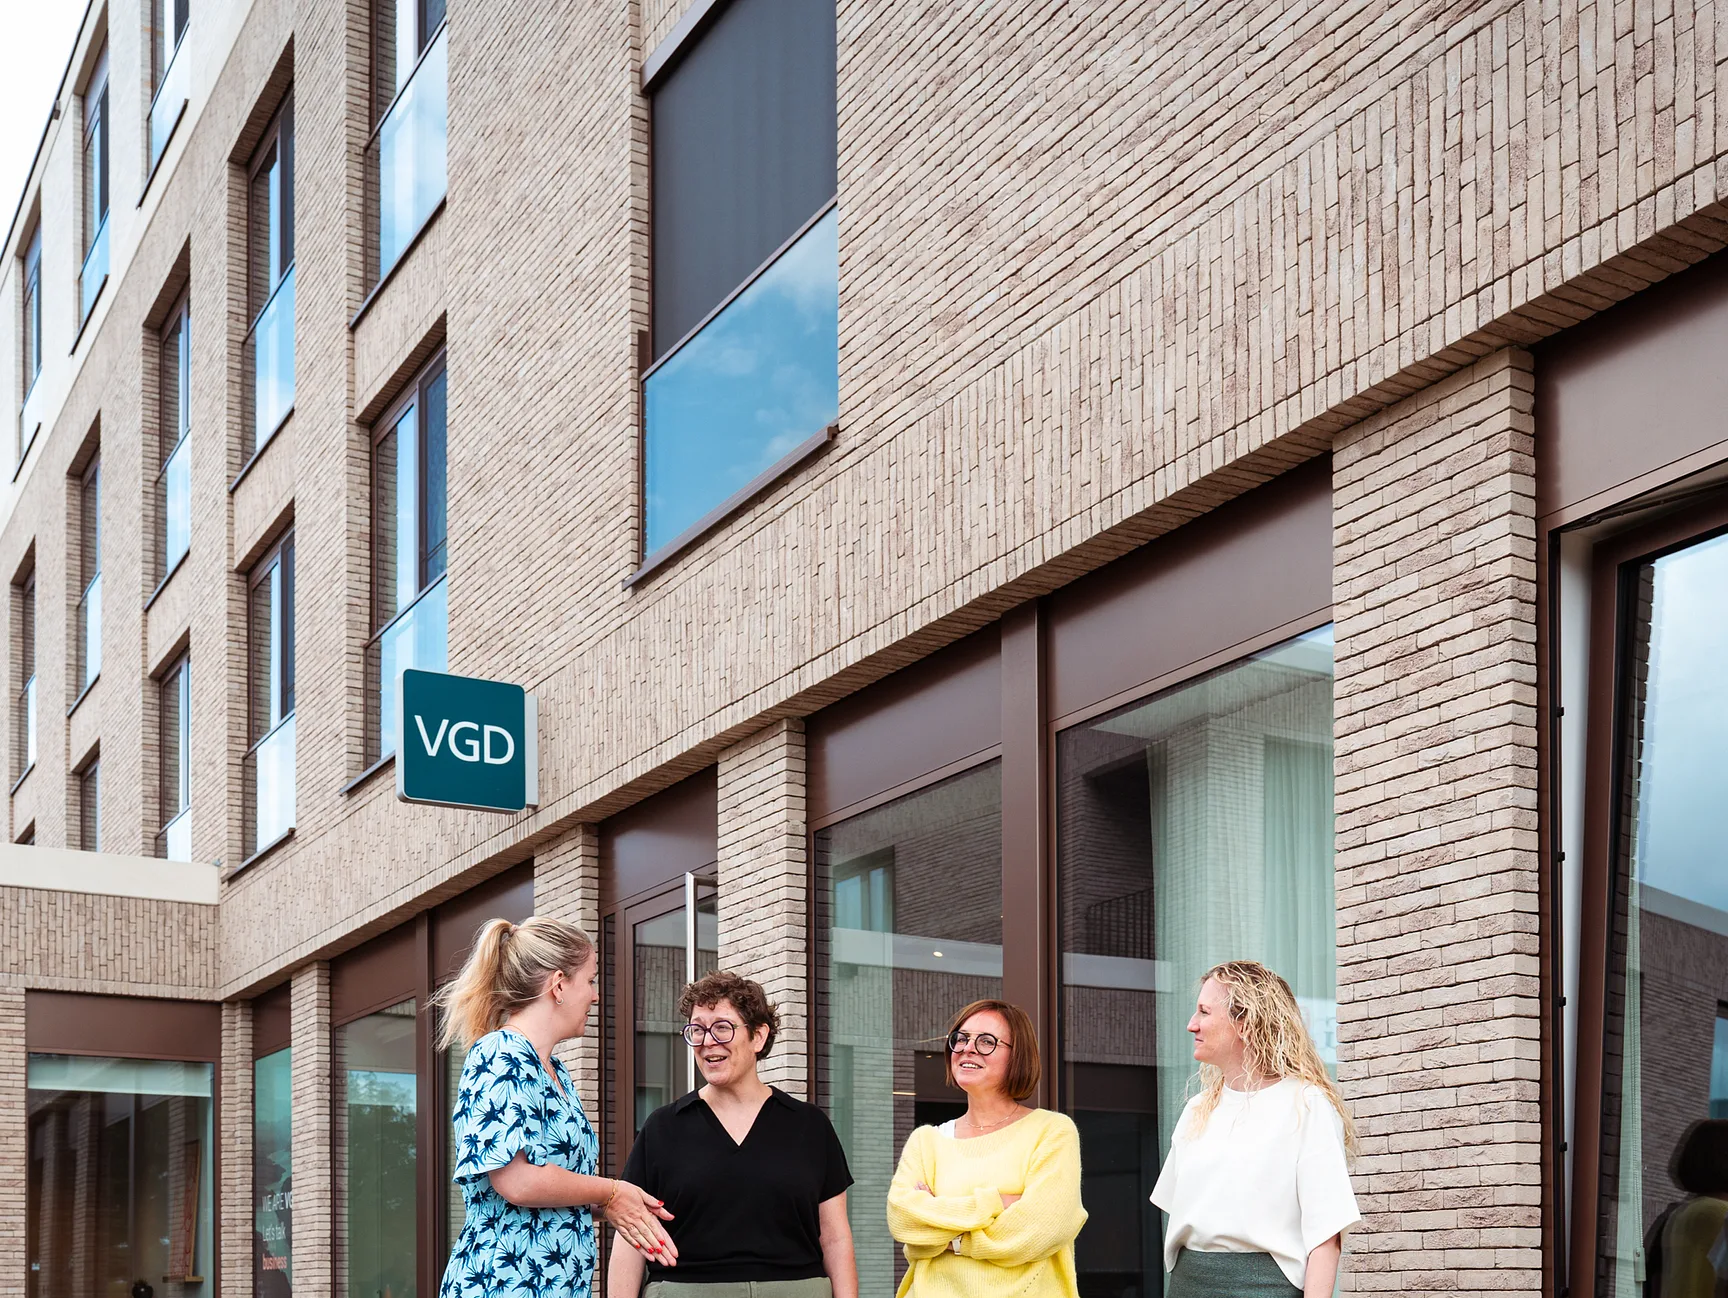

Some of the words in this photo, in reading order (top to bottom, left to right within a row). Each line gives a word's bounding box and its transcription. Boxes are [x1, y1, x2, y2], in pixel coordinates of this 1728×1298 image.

[414, 715, 515, 765] VGD
[262, 1195, 272, 1212] WE
[272, 1192, 284, 1211] ARE
[262, 1253, 287, 1270] business
